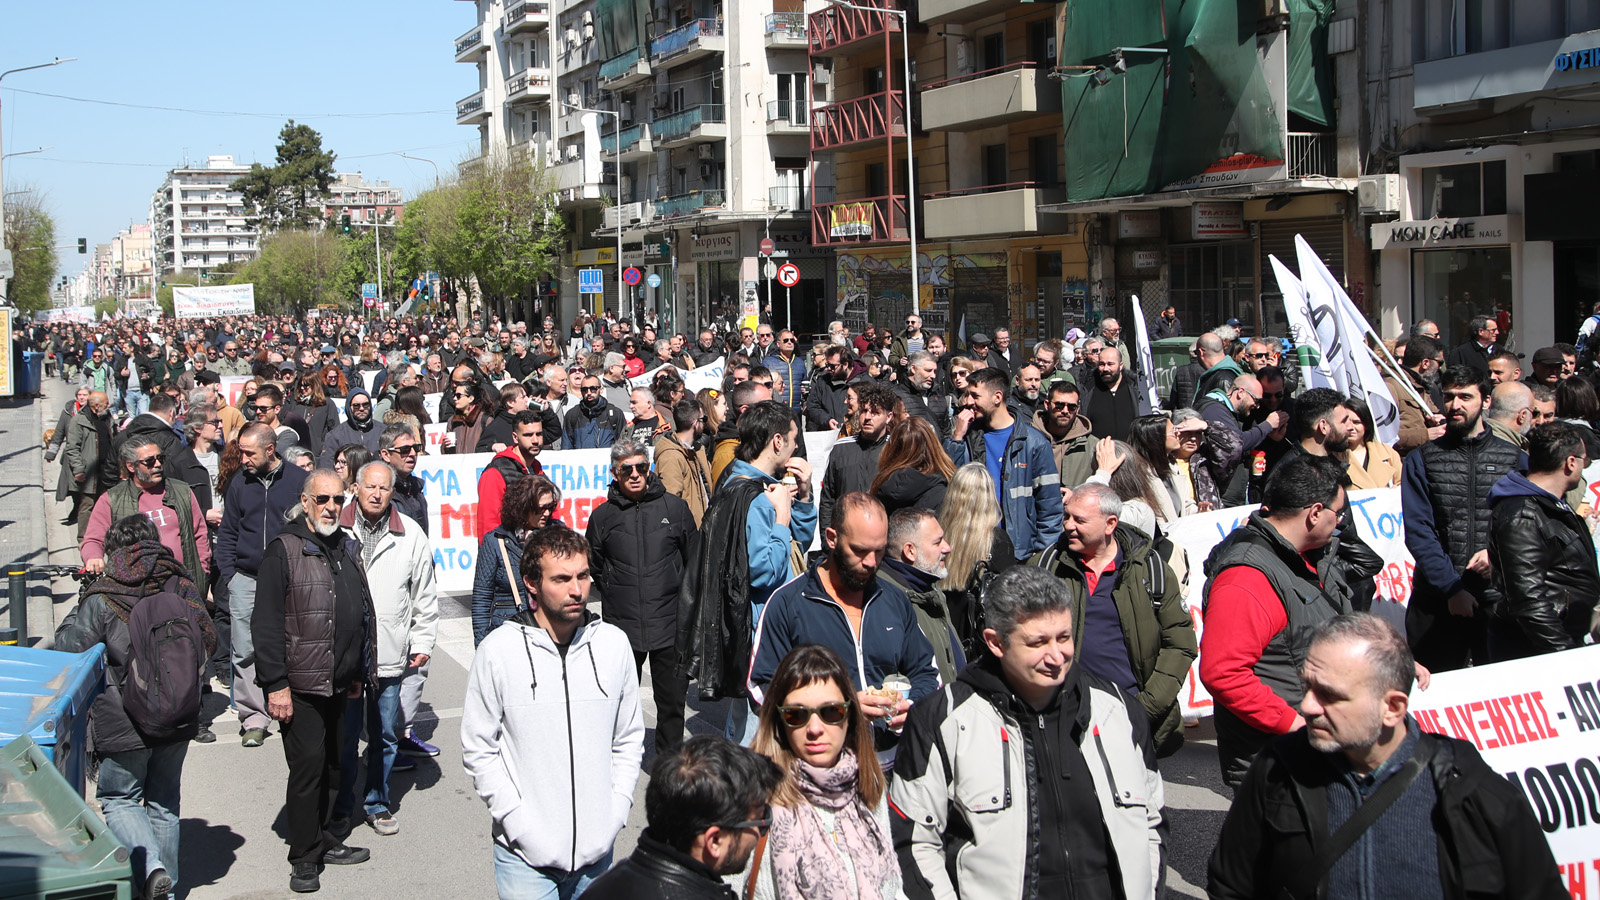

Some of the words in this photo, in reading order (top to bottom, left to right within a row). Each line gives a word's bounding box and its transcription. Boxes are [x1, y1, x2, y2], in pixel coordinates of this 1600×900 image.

[1200, 172, 1239, 184] Σπουδών
[695, 236, 732, 248] κυργιας
[1391, 226, 1426, 242] MON
[1479, 229, 1502, 238] NAILS
[415, 469, 462, 496] ΜΑ
[541, 463, 613, 491] ΓΚΛΗ
[1444, 690, 1559, 751] ΑΥΞΗΣΕΙΣ
[1505, 755, 1600, 834] ΟΠΟ
